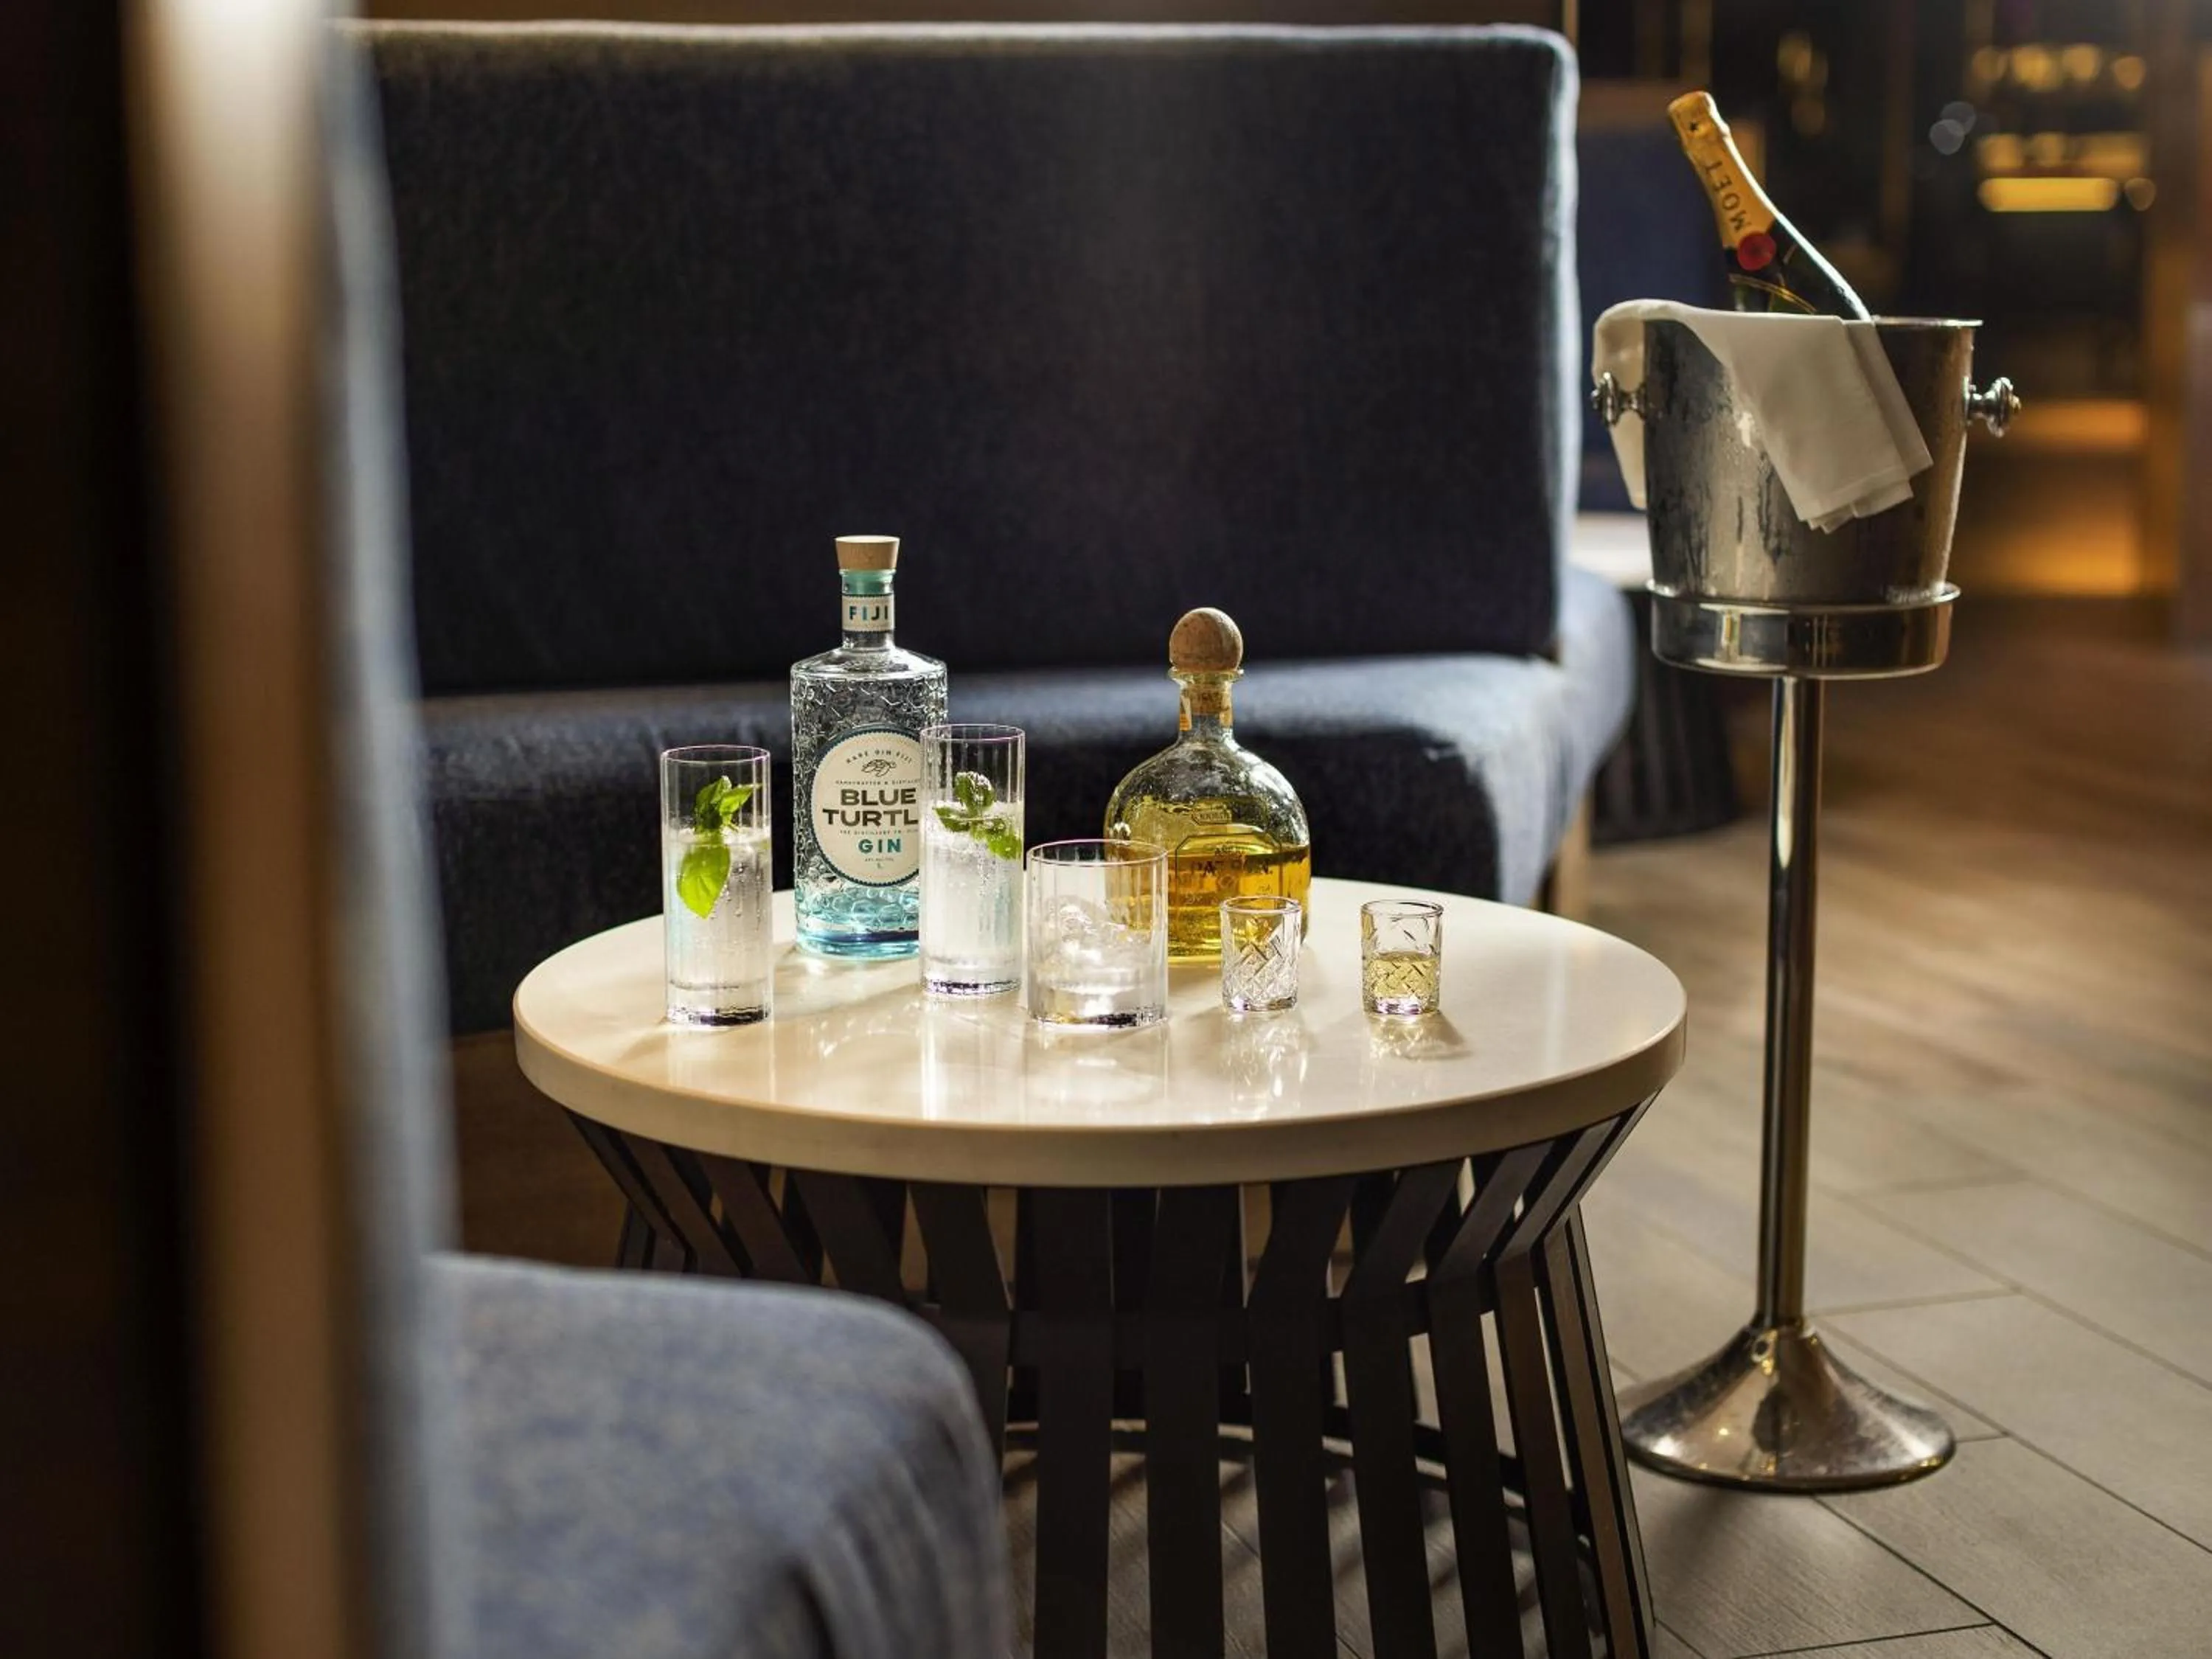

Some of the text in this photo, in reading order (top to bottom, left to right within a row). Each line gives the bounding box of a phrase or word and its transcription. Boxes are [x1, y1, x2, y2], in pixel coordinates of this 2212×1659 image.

[849, 605, 888, 621] FIJI
[841, 788, 917, 806] BLUE
[822, 809, 919, 827] TURTL
[858, 838, 902, 854] GIN
